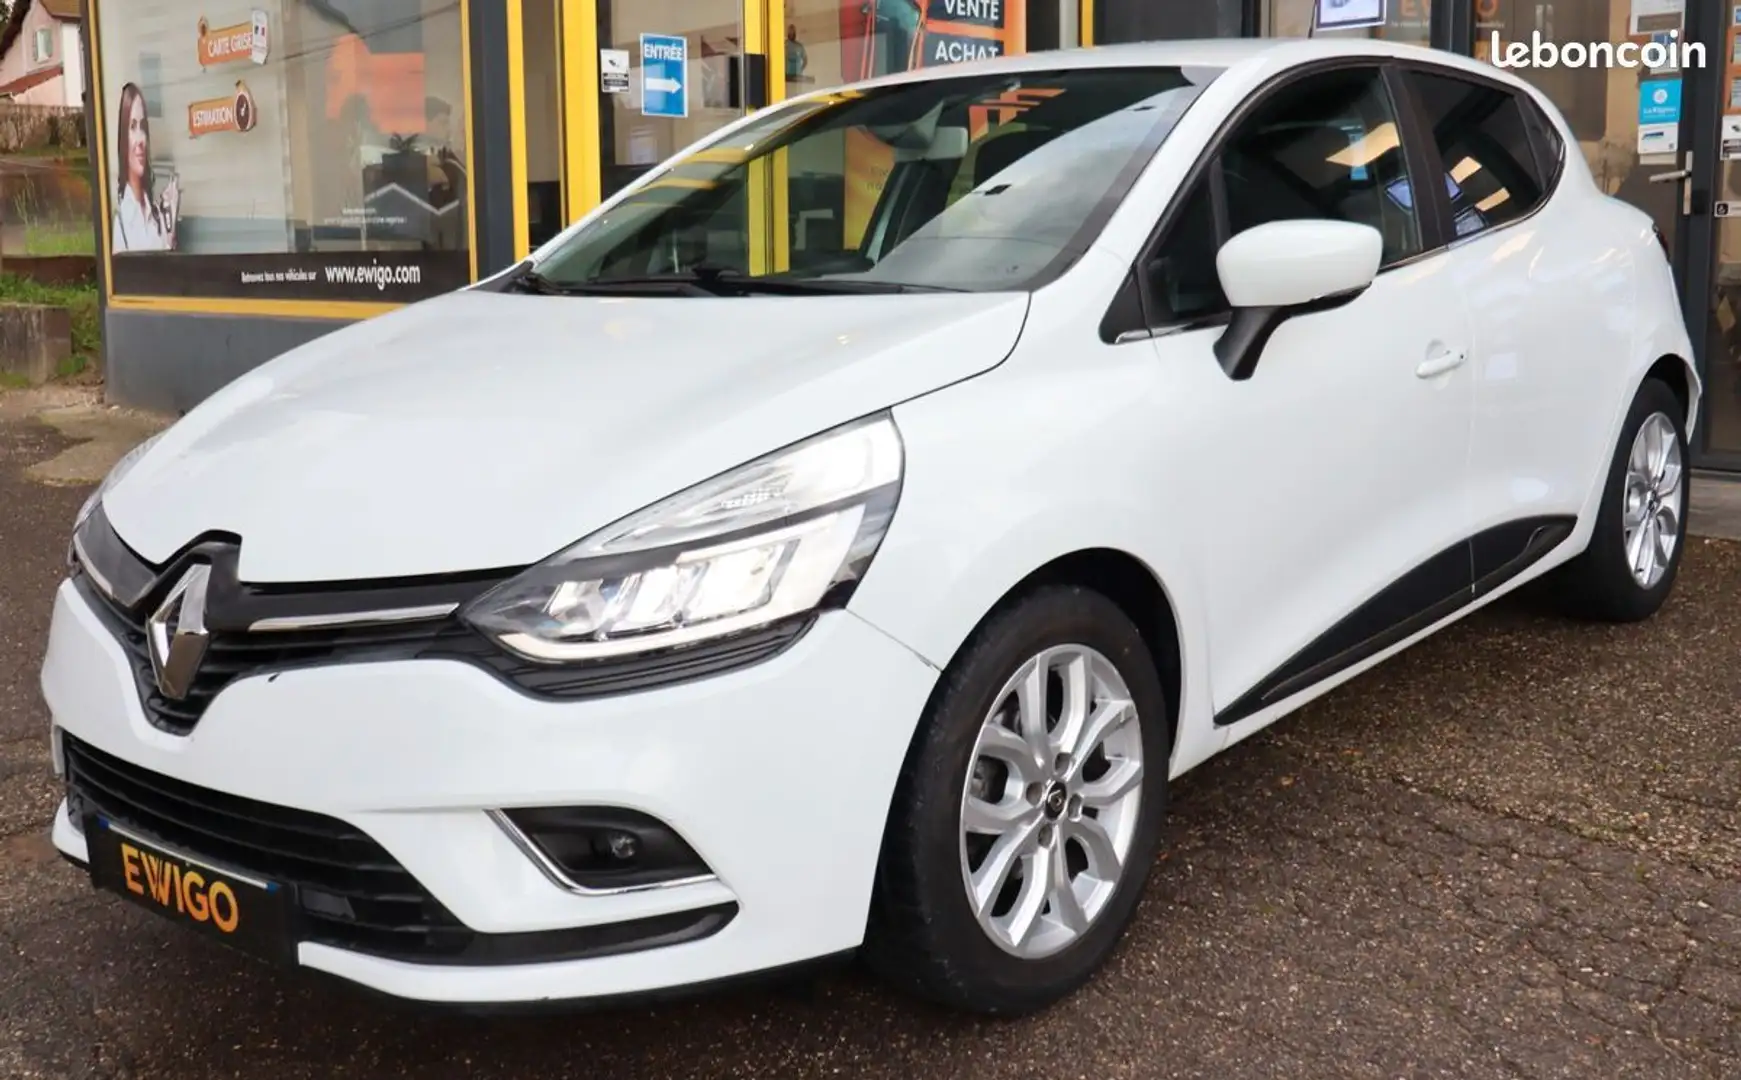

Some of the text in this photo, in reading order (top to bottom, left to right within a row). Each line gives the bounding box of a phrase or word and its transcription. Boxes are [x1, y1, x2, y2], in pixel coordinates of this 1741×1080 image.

[944, 0, 999, 20] VENTE
[208, 36, 230, 57] CARTE
[644, 43, 682, 61] ENTRÉE
[935, 40, 999, 62] ACHAT
[193, 107, 234, 127] ESTIMATION
[325, 258, 421, 290] www.ewigo.com
[121, 843, 238, 932] EWIGO
